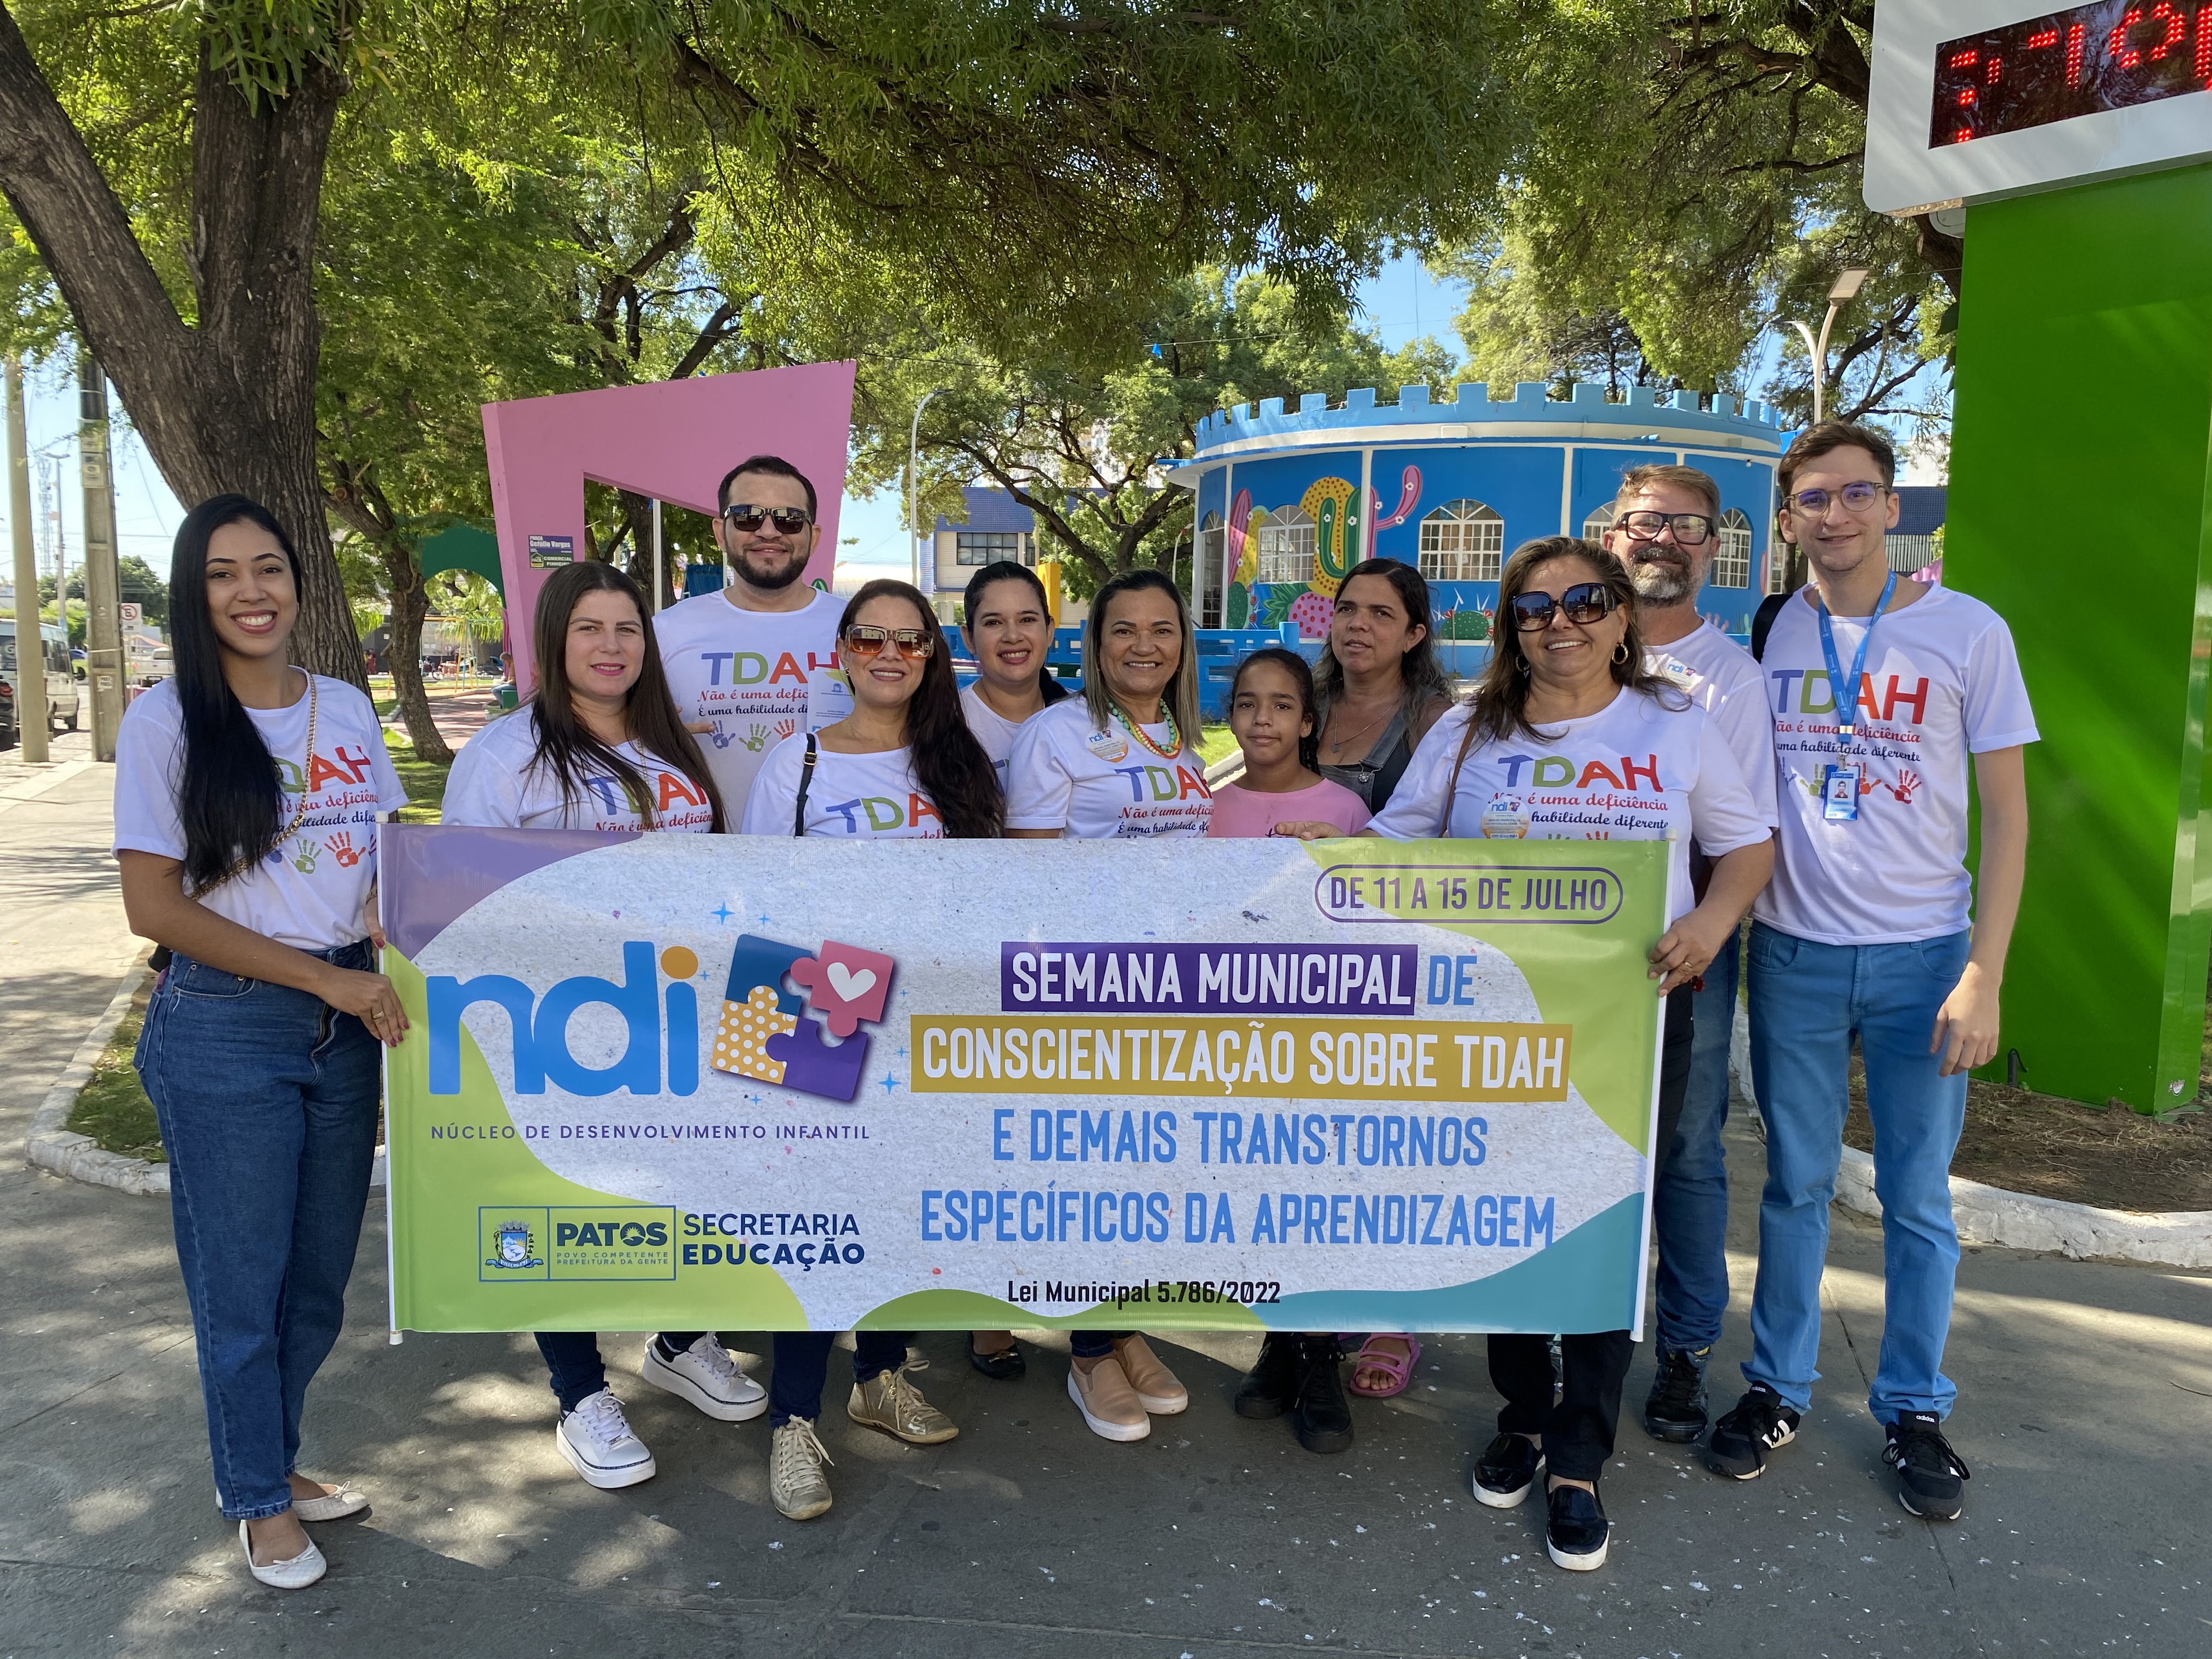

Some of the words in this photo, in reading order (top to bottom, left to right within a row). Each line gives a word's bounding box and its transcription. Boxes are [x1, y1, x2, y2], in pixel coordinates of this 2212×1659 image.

[697, 690, 726, 702] Não
[730, 690, 738, 699] é
[741, 691, 771, 699] uma
[776, 688, 808, 702] defic
[698, 704, 705, 716] É
[708, 708, 733, 716] uma
[736, 705, 795, 714] habilidade
[1776, 720, 1793, 732] ão
[1797, 720, 1804, 732] é
[1808, 724, 1839, 735] uma
[1871, 746, 1921, 761] diferente
[274, 745, 376, 794] DAH
[1498, 754, 1663, 793] TDAH
[826, 793, 944, 833] TDA
[1118, 807, 1148, 819] Não
[1151, 806, 1158, 817] é
[1492, 802, 1508, 811] ndi
[1528, 793, 1536, 804] é
[1541, 796, 1580, 805] uma
[1585, 793, 1668, 810] deficiência
[1118, 822, 1125, 834] É
[1531, 811, 1611, 825] habilidade
[1331, 877, 1364, 909] DE
[1374, 877, 1400, 909] 11
[1410, 878, 1427, 909] A
[1436, 878, 1467, 910] 15
[1478, 878, 1511, 909] DE
[1520, 879, 1607, 911] JULHO
[1012, 952, 1183, 1003] SEMANA
[1198, 953, 1412, 1005] MUNICIPAL
[1427, 955, 1478, 1006] DE
[426, 941, 699, 1097] ndi
[922, 1021, 1295, 1094] CONSCIENTIZAÇÃO
[1308, 1032, 1438, 1088] SOBRE
[1453, 1036, 1564, 1089] TDAH
[431, 1122, 515, 1139] NÚCLEO
[526, 1125, 549, 1139] DE
[560, 1125, 766, 1139] DESENVOLVIMENTO
[776, 1125, 869, 1139] INFANTIL
[993, 1109, 1014, 1160] E
[1030, 1109, 1177, 1163] DEMAIS
[1193, 1112, 1488, 1166] TRANSTORNOS
[684, 1214, 860, 1235] SECRETARIA
[922, 1181, 1170, 1243] ESPECÍFICOS
[1184, 1192, 1235, 1244] DA
[1251, 1193, 1555, 1248] APRENDIZAGEM
[557, 1222, 668, 1246] PATOS
[682, 1238, 865, 1271] EDUCAÇÃO
[1008, 1280, 1037, 1302] Lei
[1046, 1279, 1150, 1310] Municipal
[1158, 1280, 1280, 1304] 5.786/2022
